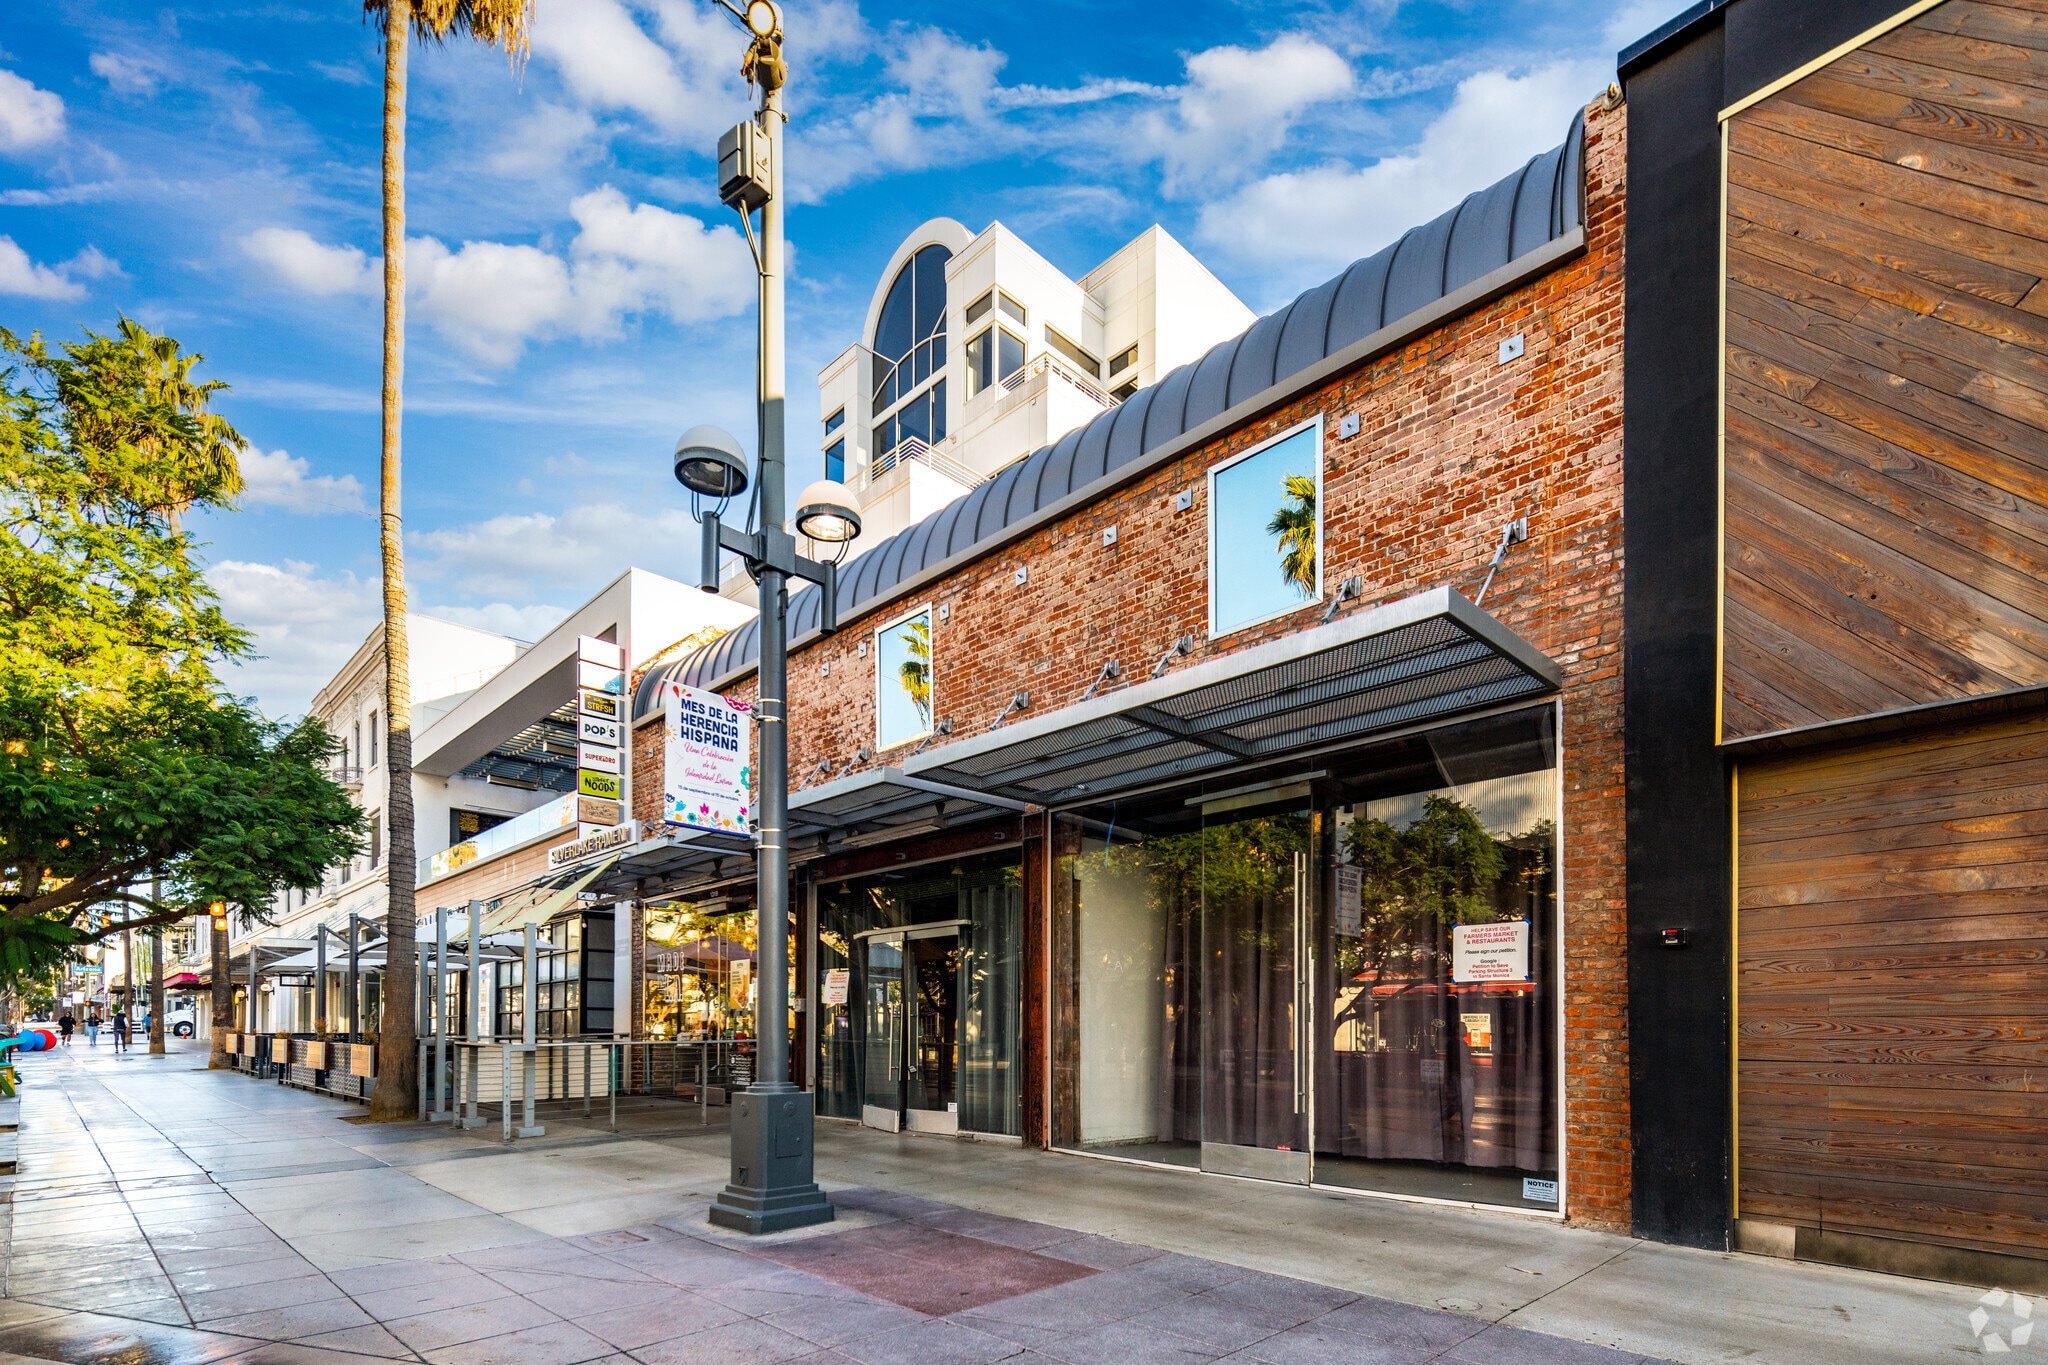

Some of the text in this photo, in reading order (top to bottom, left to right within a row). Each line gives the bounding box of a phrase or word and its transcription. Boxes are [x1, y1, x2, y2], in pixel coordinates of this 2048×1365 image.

[681, 698, 738, 725] MES DE LA
[585, 723, 616, 738] POP'S
[681, 712, 738, 739] HERENCIA
[681, 726, 738, 752] HISPANA
[703, 760, 710, 768] de
[585, 777, 616, 793] NOODS
[552, 826, 627, 863] SILVERLAKE RAMEN
[657, 952, 685, 973] MADE
[1528, 1180, 1554, 1188] NOTICE
